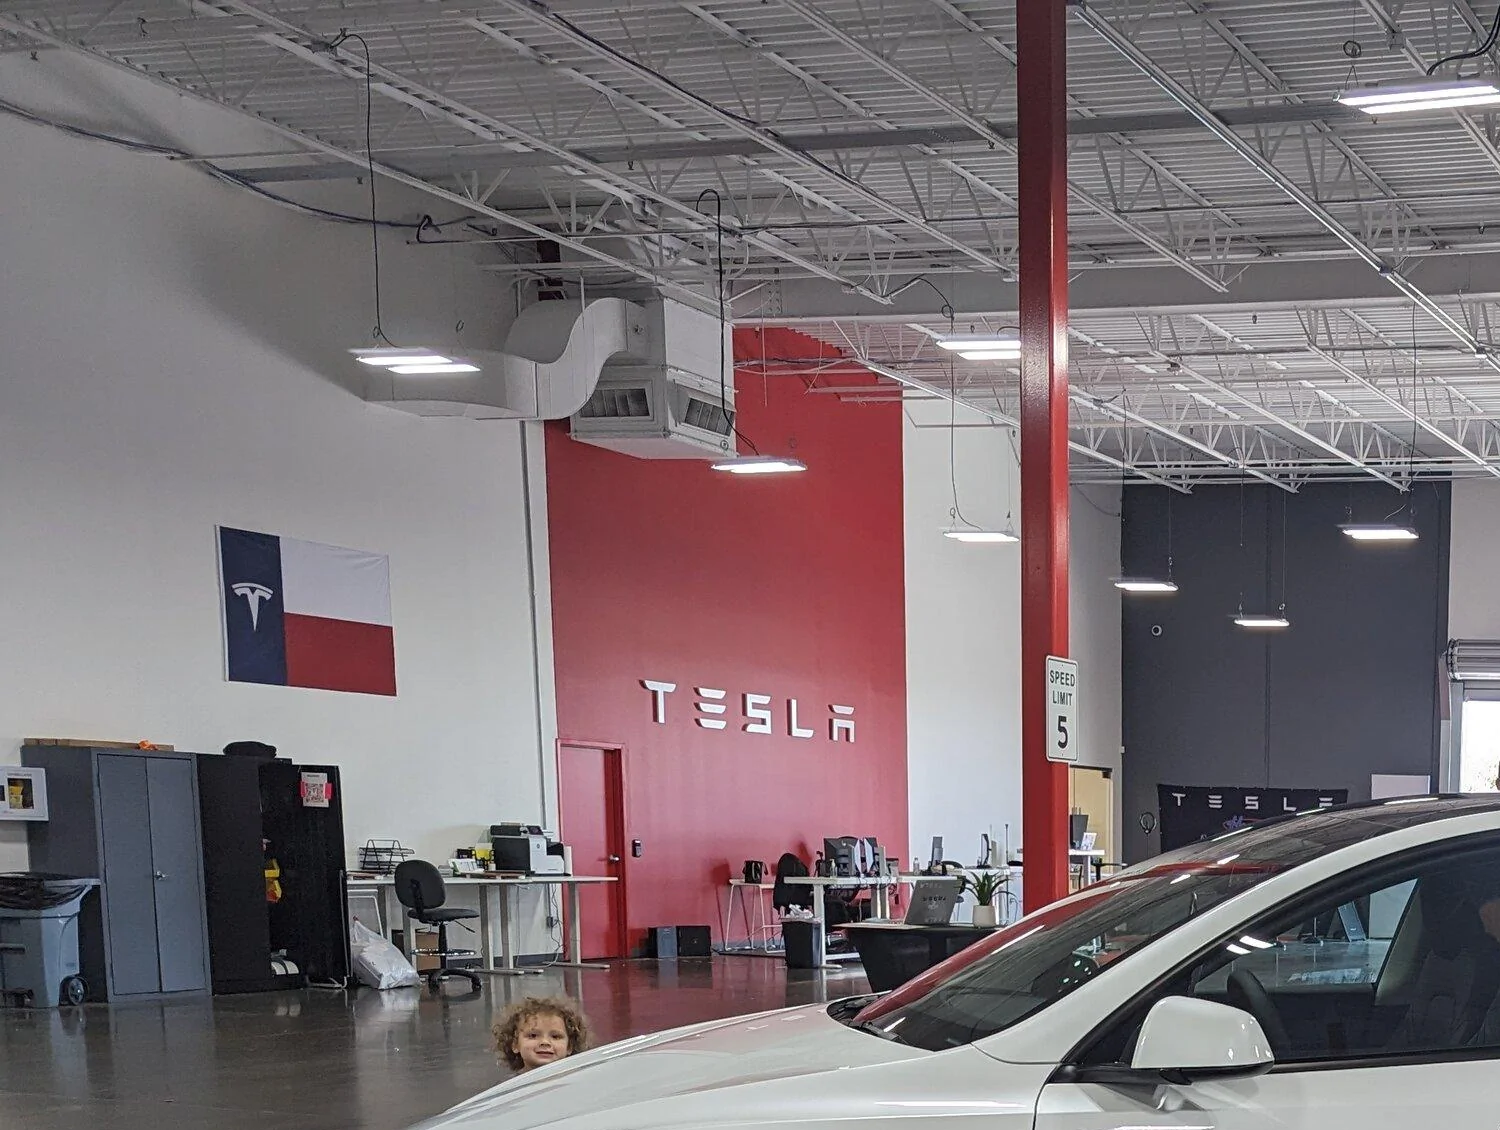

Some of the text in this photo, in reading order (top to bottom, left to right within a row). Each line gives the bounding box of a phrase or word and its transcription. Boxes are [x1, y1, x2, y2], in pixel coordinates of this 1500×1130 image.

[1049, 669, 1076, 687] SPEED
[1052, 690, 1073, 706] LIMIT
[640, 679, 855, 743] TESLA
[1057, 715, 1069, 749] 5
[1171, 792, 1334, 812] TESLA
